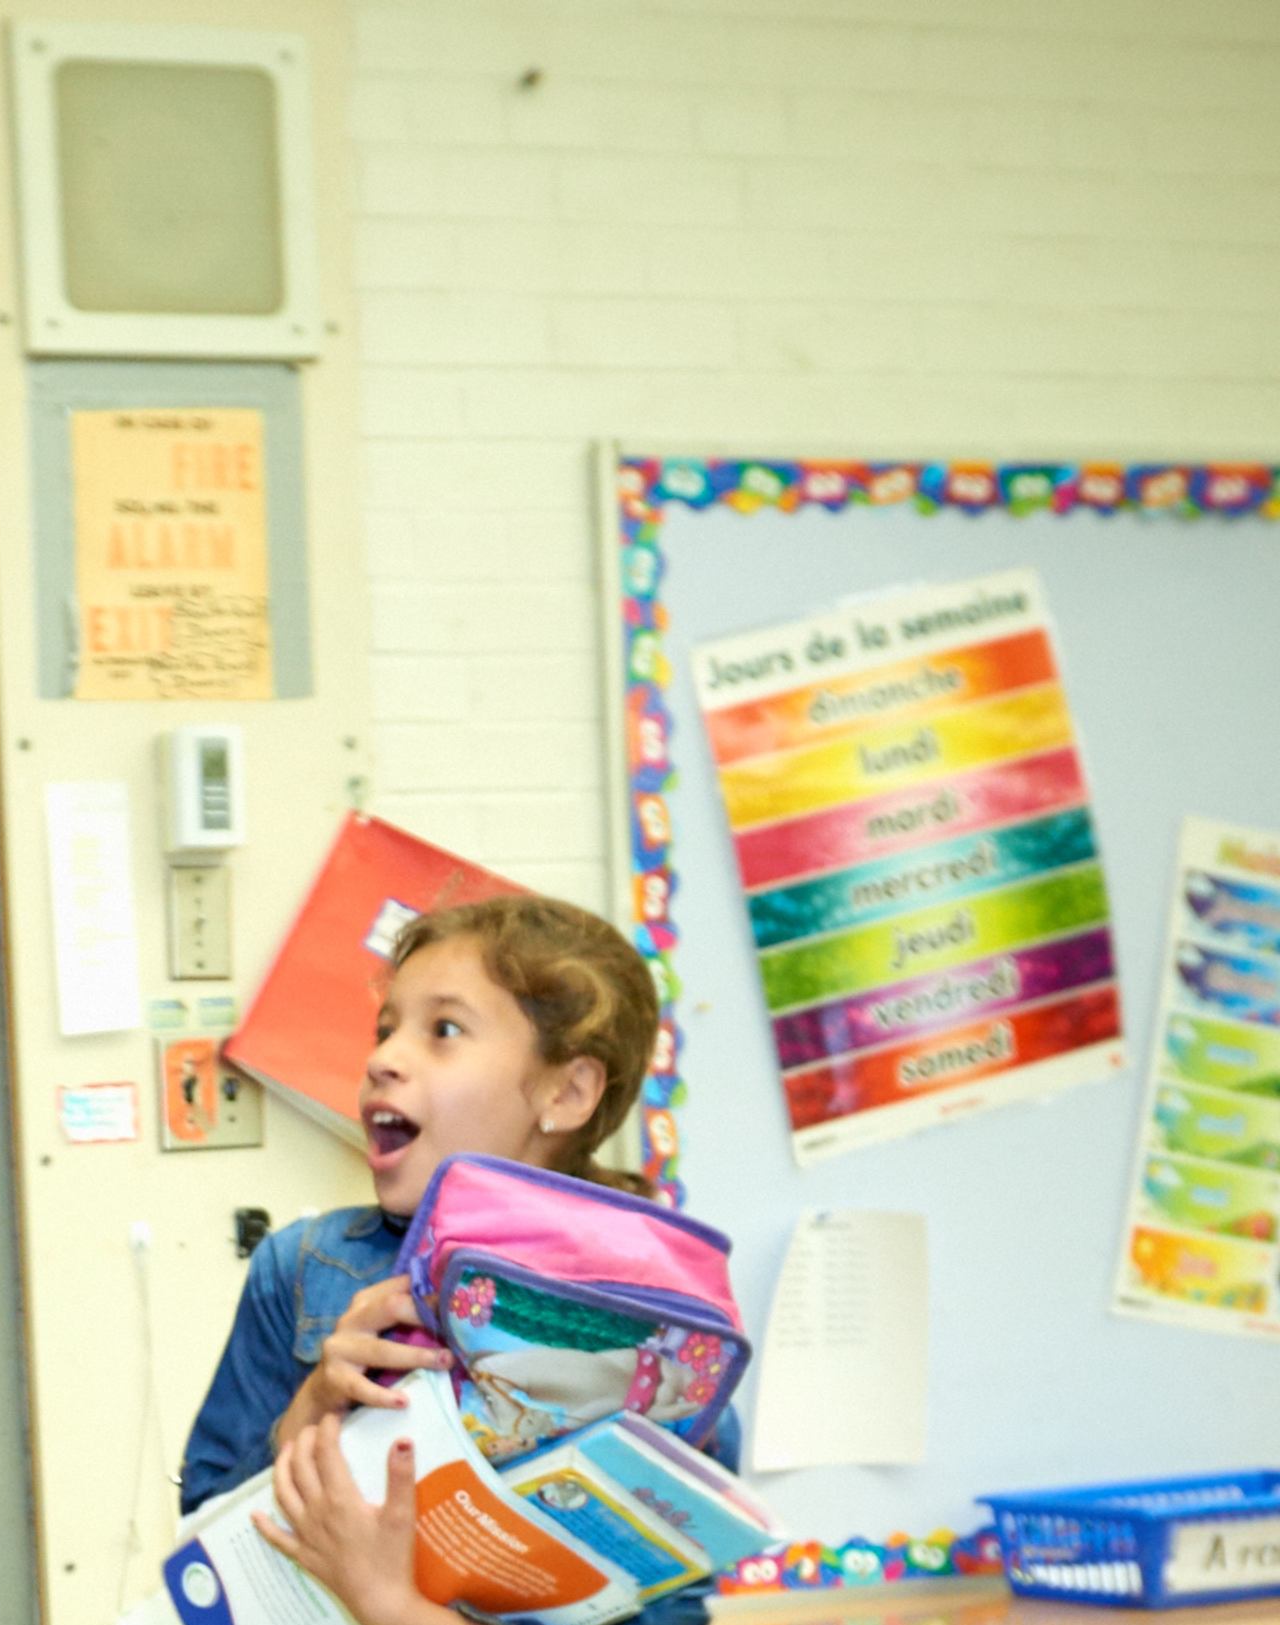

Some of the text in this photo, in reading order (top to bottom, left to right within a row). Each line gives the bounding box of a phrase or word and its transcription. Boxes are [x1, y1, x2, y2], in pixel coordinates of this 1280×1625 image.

[171, 442, 257, 492] FIRE
[107, 522, 236, 570] ALARM
[707, 592, 1029, 690] Jours de la semaine
[808, 668, 964, 724] dimanche
[858, 725, 940, 776] lundi
[866, 787, 958, 838] mardi
[852, 838, 997, 906] mercredi
[890, 906, 977, 970] jeudi
[872, 953, 1019, 1028] vendredi
[900, 1020, 1012, 1084] samedi
